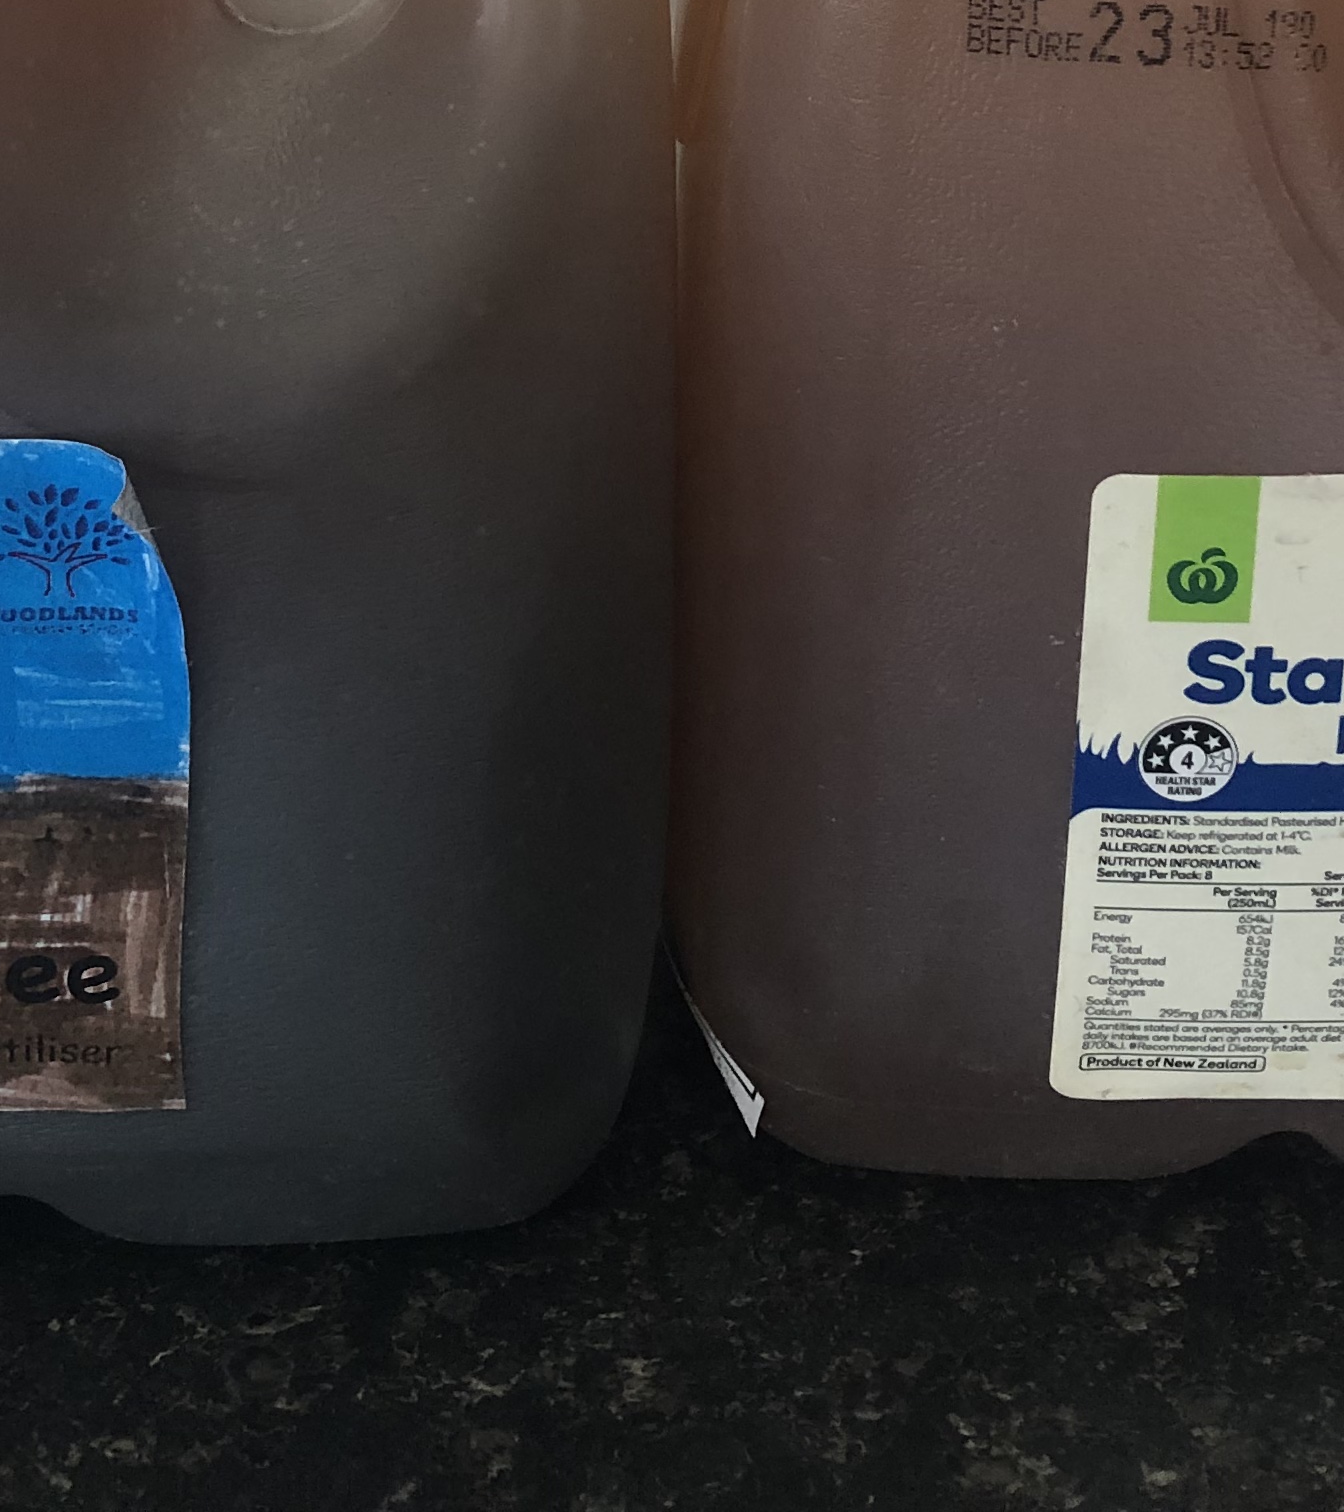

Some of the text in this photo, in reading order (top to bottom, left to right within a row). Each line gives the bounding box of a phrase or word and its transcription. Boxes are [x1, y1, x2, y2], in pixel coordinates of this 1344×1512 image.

[1089, 1, 1174, 66] 23
[966, 23, 1084, 62] BEFORE
[1181, 751, 1194, 769] 4
[1156, 776, 1215, 785] HEALTH STAR
[1168, 787, 1202, 795] RATING
[1101, 813, 1190, 825] INGREDIENTS:
[1193, 816, 1268, 826] Standardised
[1272, 817, 1337, 826] Pasteurised
[1100, 827, 1164, 838] STORAGE:
[1167, 830, 1196, 841] Keep
[1198, 830, 1264, 842] refrigerated
[1265, 832, 1278, 840] at
[1099, 842, 1167, 853] ALLERGEN
[1168, 845, 1219, 854] ADVICE:
[1222, 845, 1273, 855] Contains
[1098, 856, 1261, 869] NUTRITION INFORMATION:
[1097, 868, 1146, 881] Servings
[1149, 869, 1168, 879] Per
[1205, 871, 1213, 880] 8
[1213, 887, 1232, 896] Per
[1234, 887, 1277, 899] Serving
[1228, 898, 1276, 908] (250mL)
[1094, 911, 1132, 924] Energy
[1092, 933, 1131, 943] Protein
[1117, 946, 1142, 955] Total
[1110, 955, 1166, 966] Saturated
[1110, 966, 1139, 976] Trans
[1088, 976, 1165, 987] Carbohydrate
[1107, 987, 1145, 997] Sugars
[1086, 996, 1128, 1006] Sodium
[1085, 1007, 1132, 1016] Calcium
[1084, 1021, 1140, 1031] Quantities
[1144, 1024, 1179, 1032] stated
[1202, 1026, 1251, 1035] averages
[1083, 1033, 1108, 1041] daily
[1173, 1034, 1206, 1043] based
[1243, 1036, 1287, 1045] average
[1289, 1034, 1318, 1043] adult
[1321, 1033, 1341, 1042] diet
[1228, 1044, 1268, 1054] Dietary
[1087, 1057, 1257, 1069] Product of New Zealand
